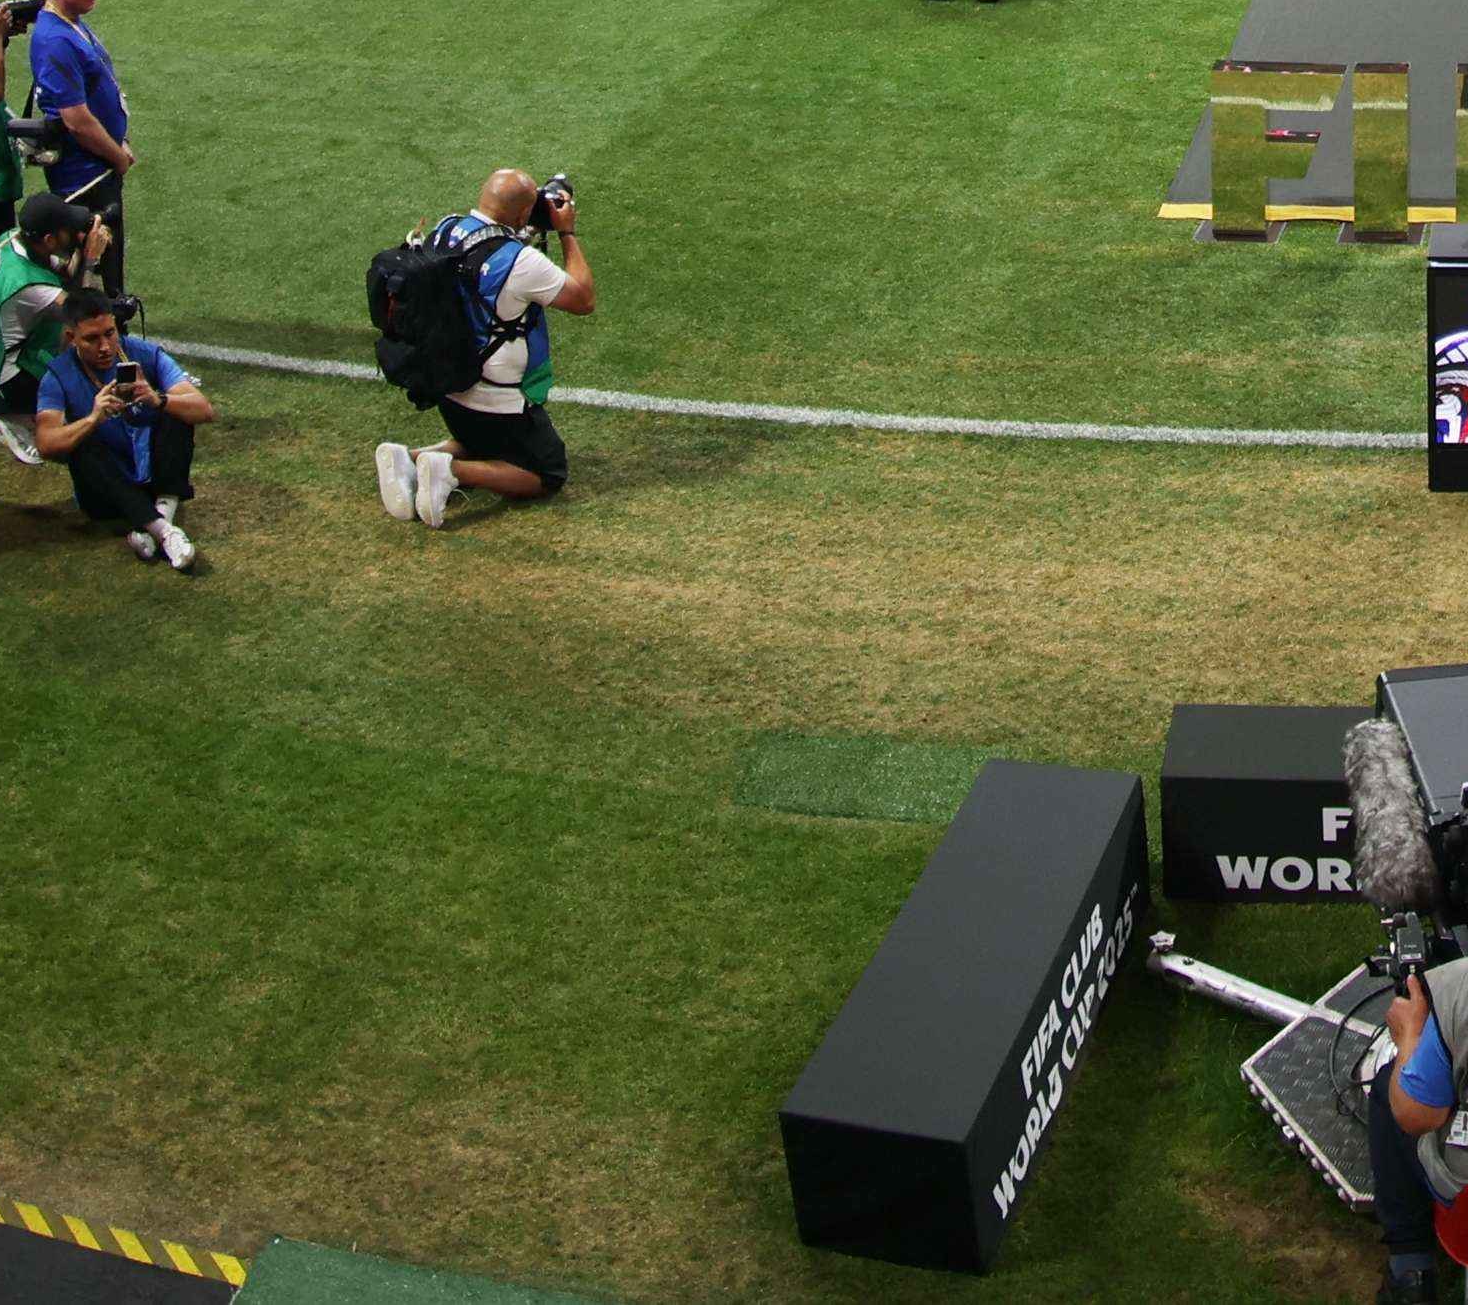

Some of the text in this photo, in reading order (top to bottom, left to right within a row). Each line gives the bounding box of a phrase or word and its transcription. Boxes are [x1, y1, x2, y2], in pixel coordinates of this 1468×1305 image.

[1213, 855, 1363, 891] WOR
[1020, 903, 1104, 1099] FIFA CLUB
[993, 1063, 1063, 1219] WORLD
[1060, 983, 1094, 1071] CUP
